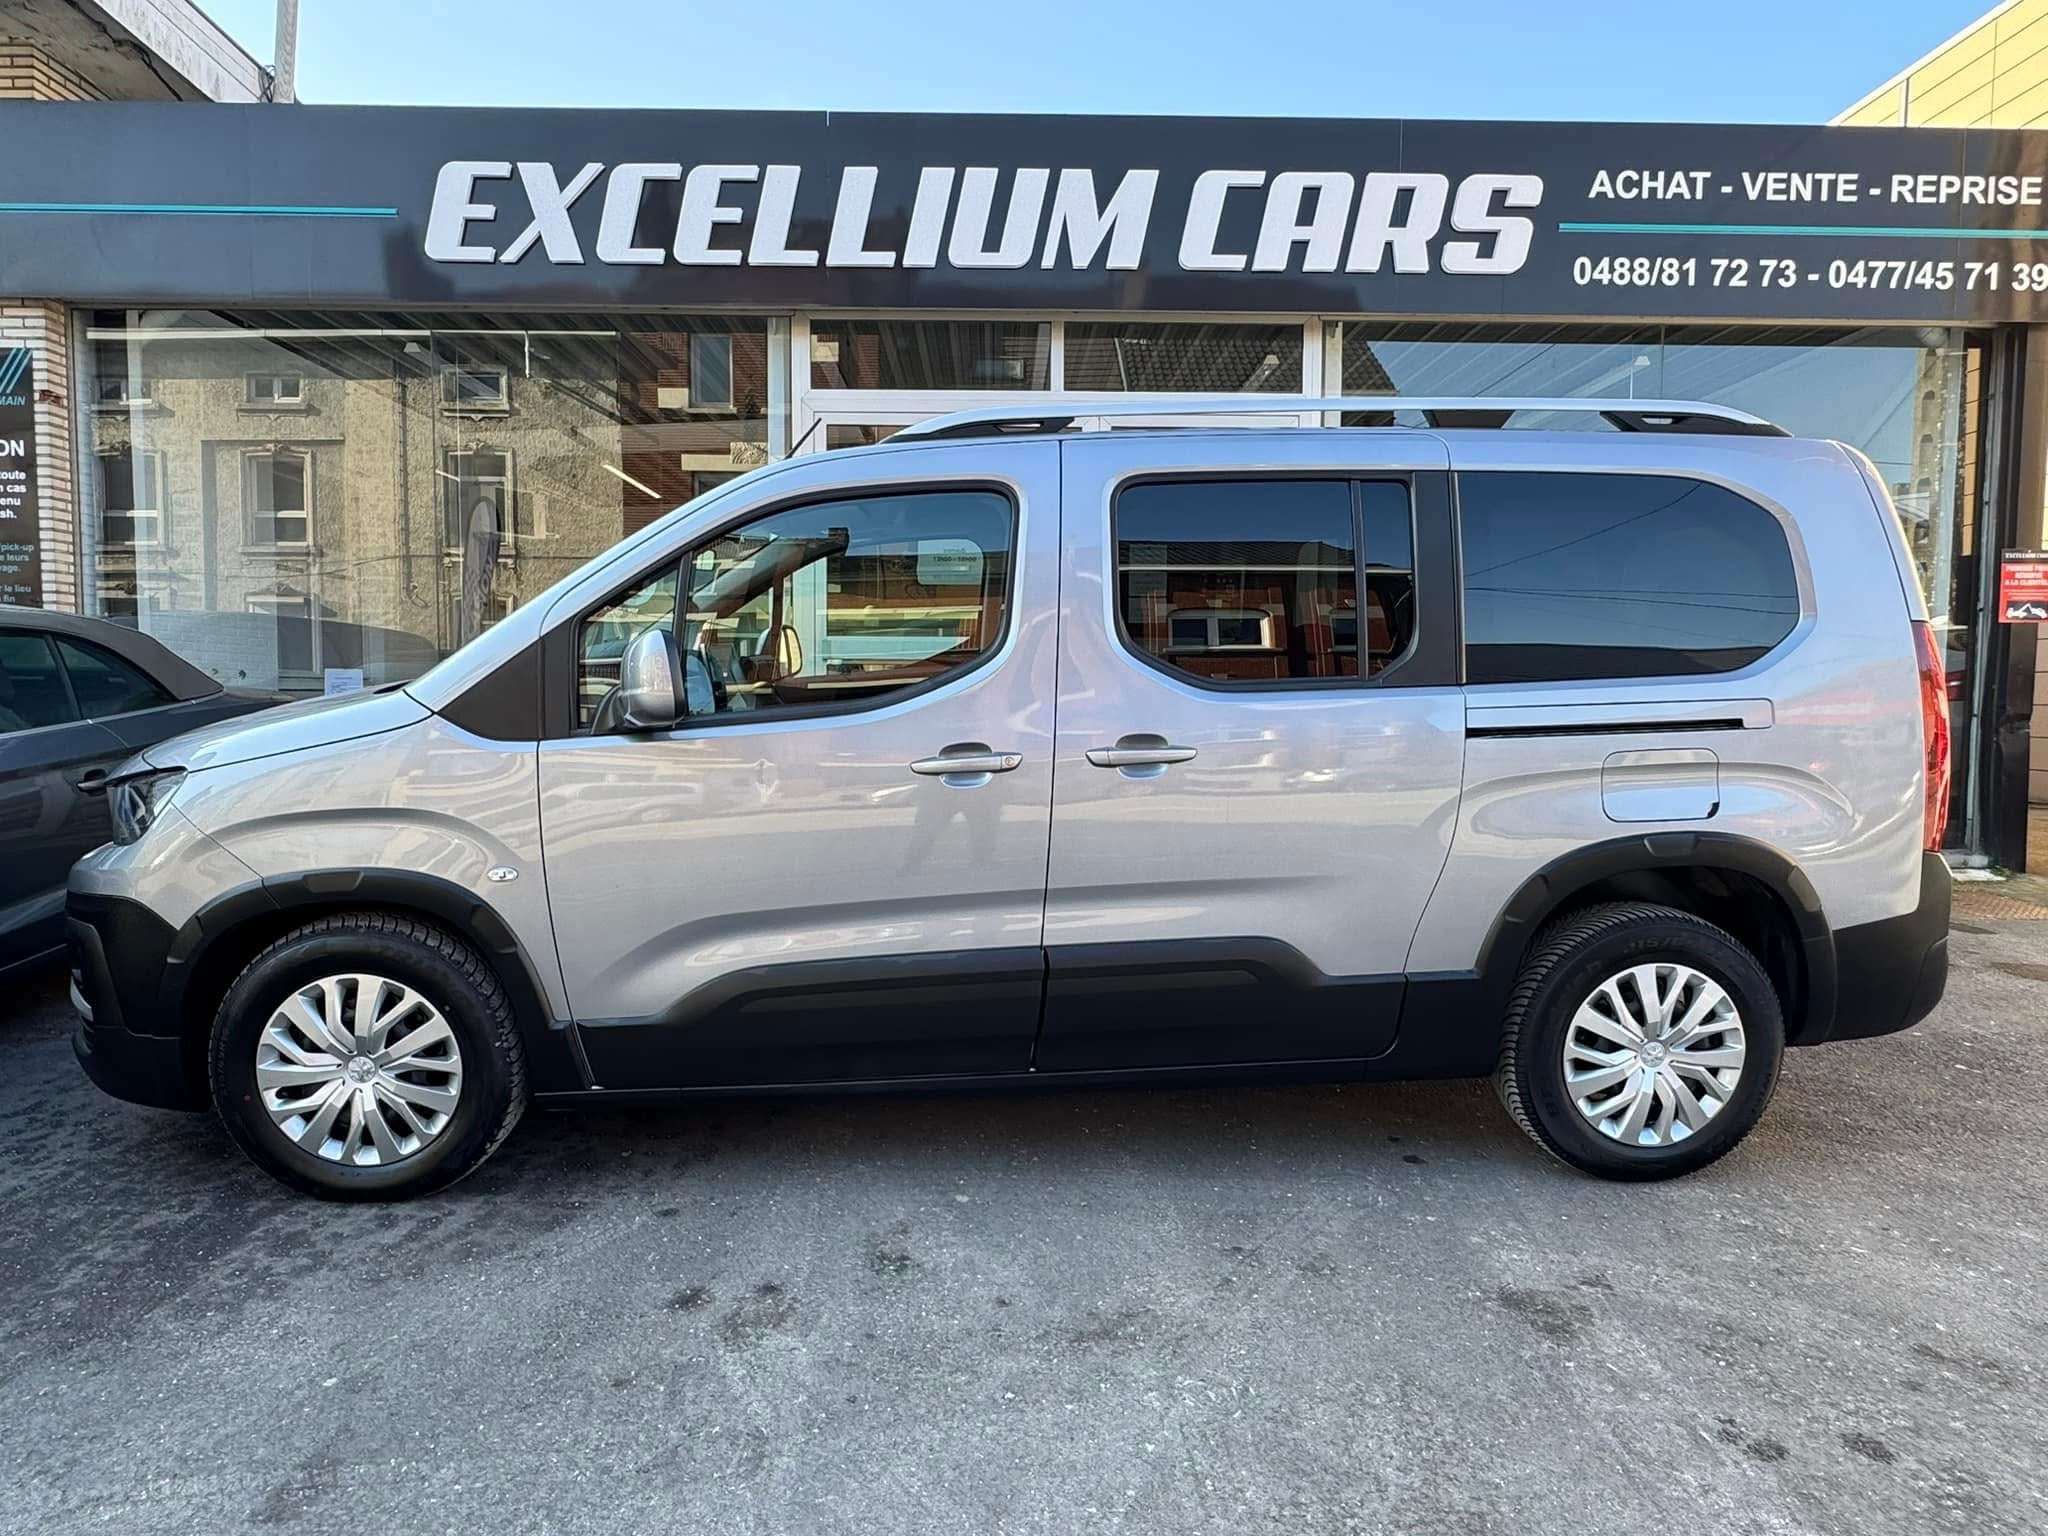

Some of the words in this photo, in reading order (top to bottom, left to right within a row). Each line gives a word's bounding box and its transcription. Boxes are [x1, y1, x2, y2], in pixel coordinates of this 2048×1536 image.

[1588, 169, 1712, 200] ACHAT
[1720, 185, 1733, 194] -
[1741, 171, 1859, 202] VENTE
[1868, 187, 1882, 196] -
[1890, 174, 2043, 206] REPRISE
[424, 160, 1160, 270] EXCELLIUM
[1178, 169, 1545, 276] CARS
[1573, 256, 1697, 287] 0488/81
[1710, 258, 1749, 287] 72
[1759, 259, 1797, 288] 73
[1828, 259, 1955, 291] 0477/45
[1964, 262, 1999, 291] 71
[2011, 262, 2048, 292] 39
